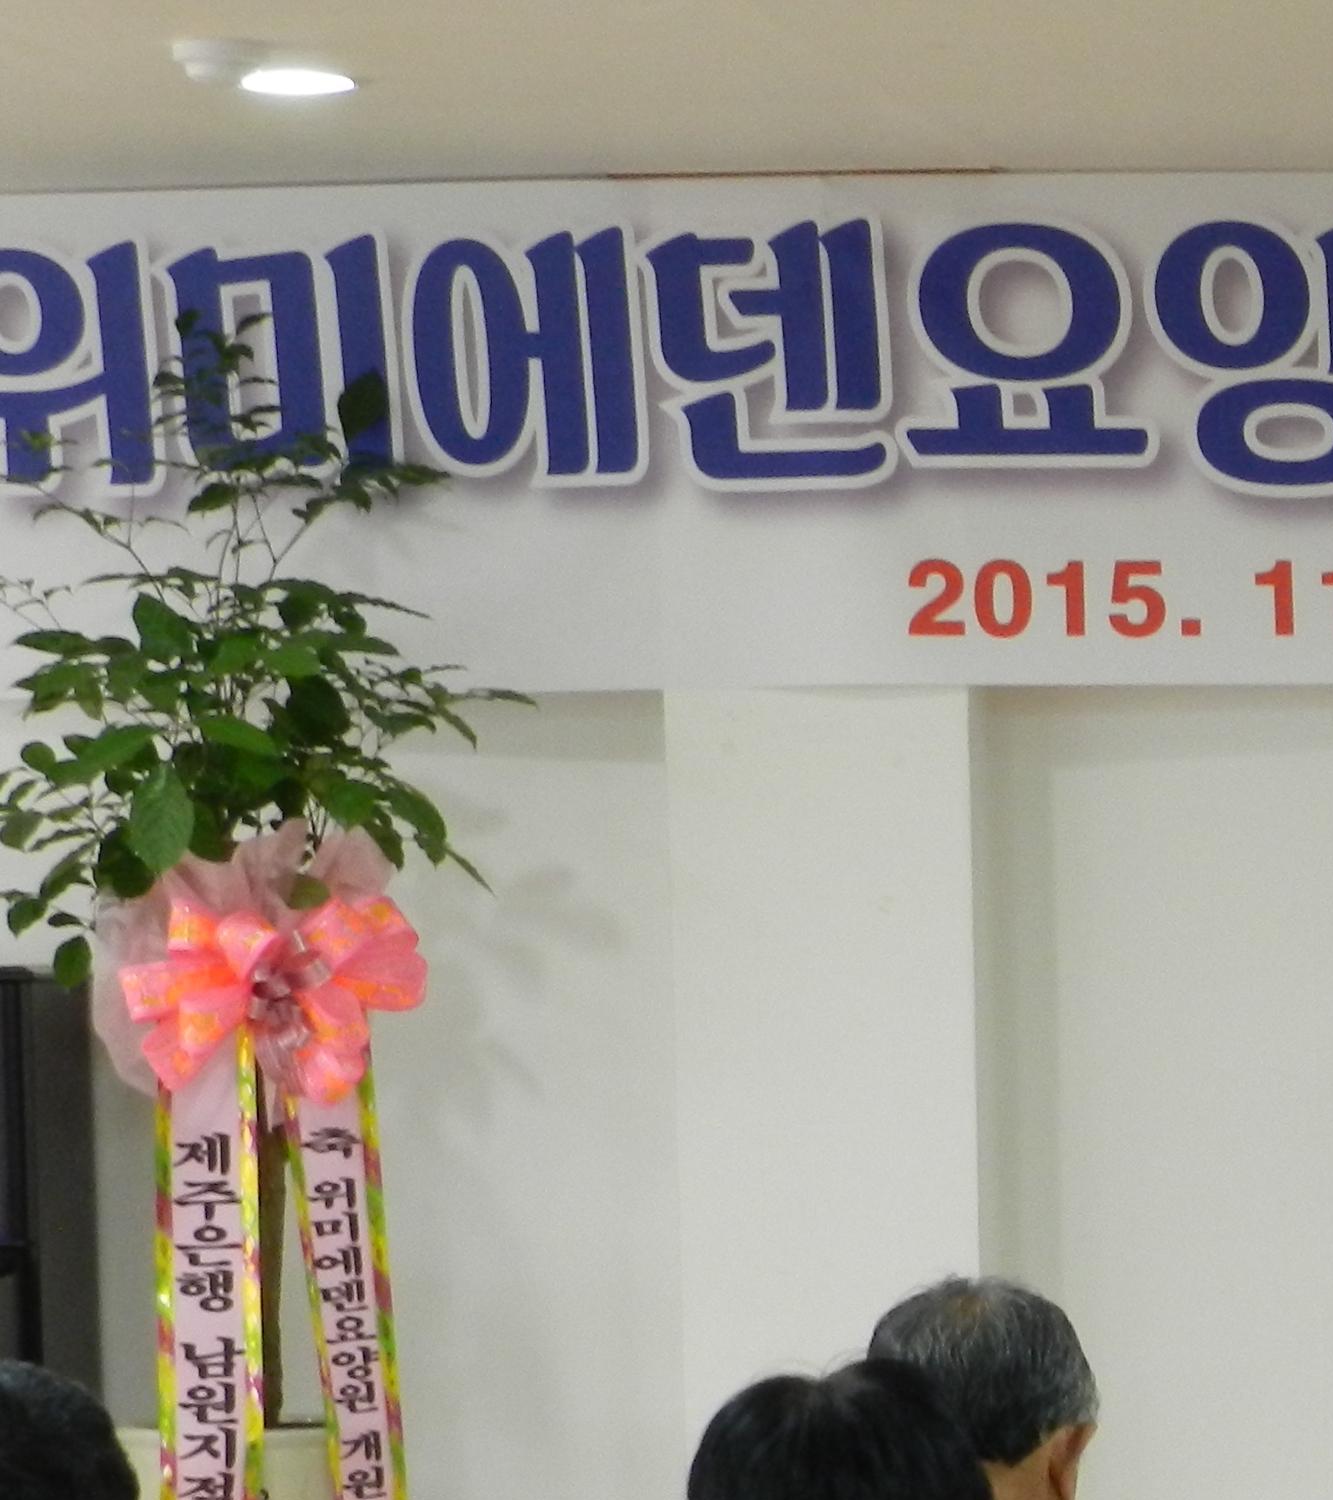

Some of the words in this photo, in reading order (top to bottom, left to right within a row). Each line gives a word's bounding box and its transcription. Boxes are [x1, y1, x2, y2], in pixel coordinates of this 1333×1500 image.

[907, 557, 1203, 639] 2015.
[173, 1132, 243, 1313] 제주은행
[306, 1176, 382, 1414] 위미에덴요양원
[340, 1430, 388, 1500] 개원
